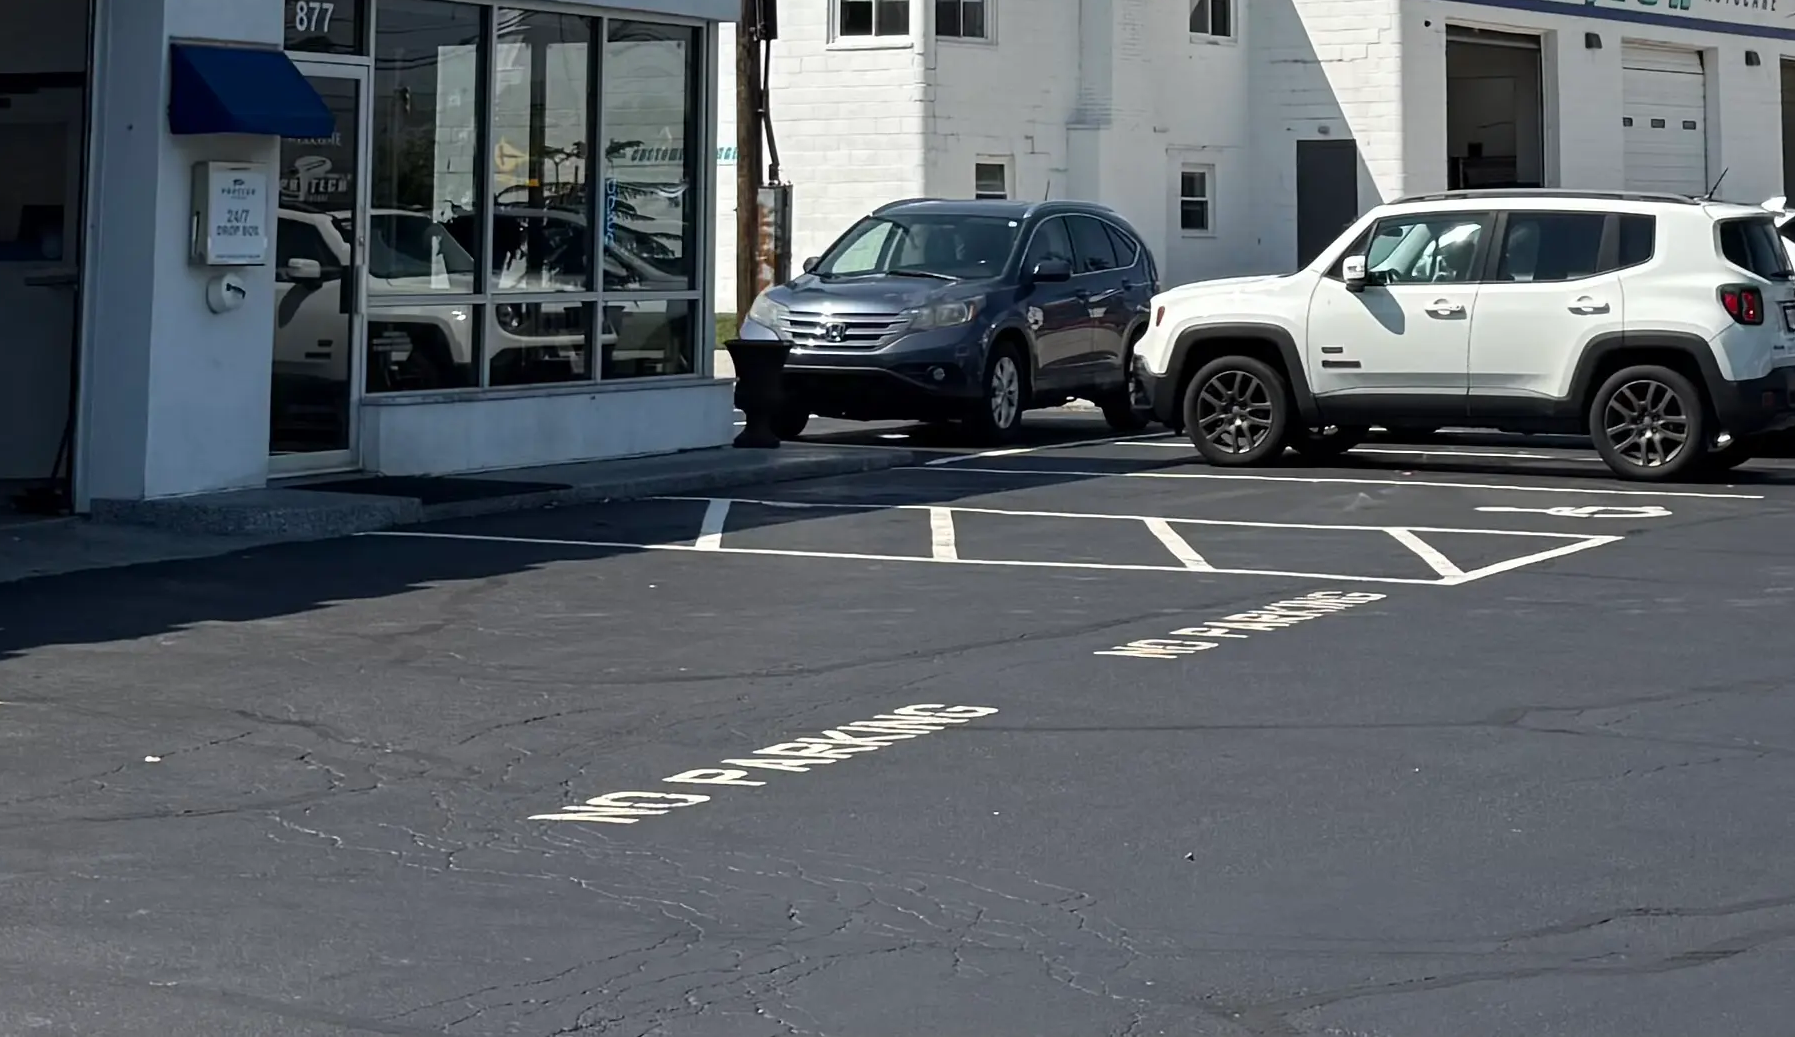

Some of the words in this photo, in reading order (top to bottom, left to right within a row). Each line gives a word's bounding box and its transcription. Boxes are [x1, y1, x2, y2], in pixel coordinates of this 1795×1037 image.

[295, 0, 335, 33] 877
[227, 209, 251, 224] 24/7
[1094, 638, 1219, 660] NO
[1180, 590, 1387, 639] PARKING
[527, 790, 711, 824] NO
[663, 702, 1000, 787] PARKING
